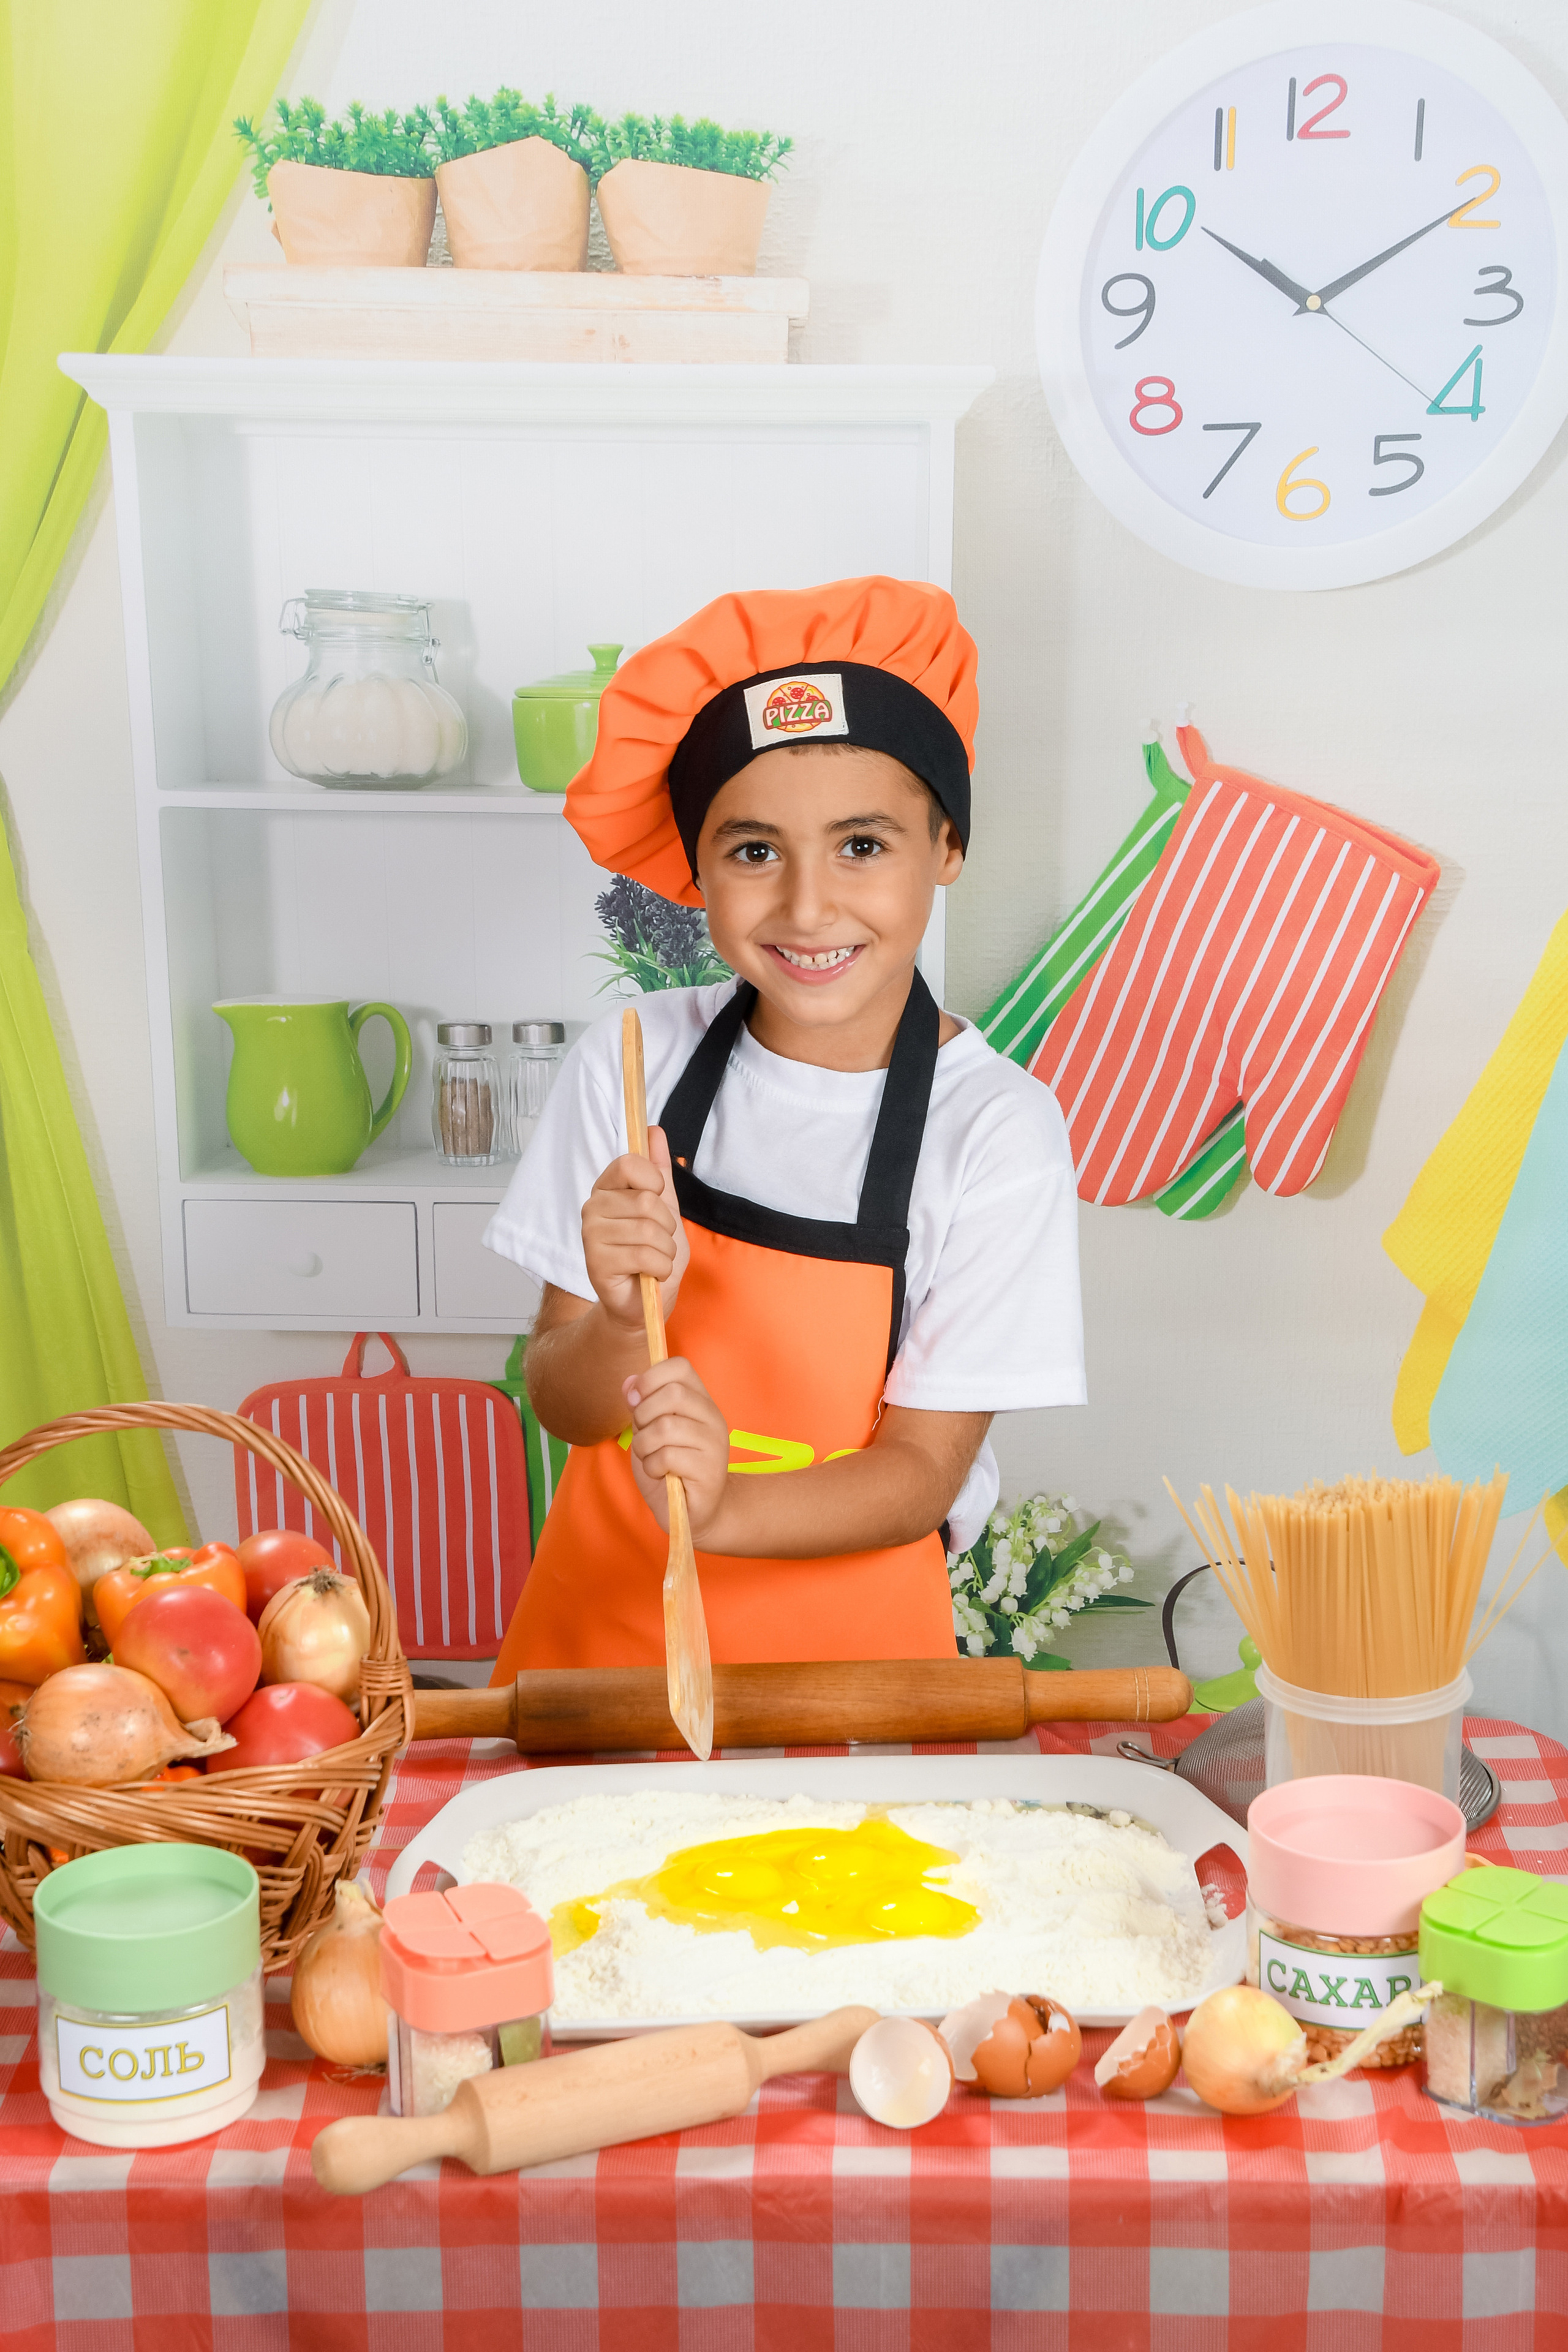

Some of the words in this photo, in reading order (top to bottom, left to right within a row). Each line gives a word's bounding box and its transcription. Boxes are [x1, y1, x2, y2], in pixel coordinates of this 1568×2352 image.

[1213, 106, 1237, 171] 11
[1285, 73, 1351, 140] 12
[1413, 98, 1425, 162] 1
[1135, 185, 1196, 252] 10
[1446, 164, 1502, 229] 2
[1101, 272, 1156, 350] 9
[1463, 265, 1525, 327] 3
[1129, 375, 1184, 437] 8
[1425, 344, 1487, 423] 4
[1202, 422, 1262, 499] 7
[1276, 445, 1331, 522] 6
[1368, 434, 1425, 497] 5
[766, 701, 830, 727] PIZZA
[80, 2040, 205, 2081] СОЛЬ
